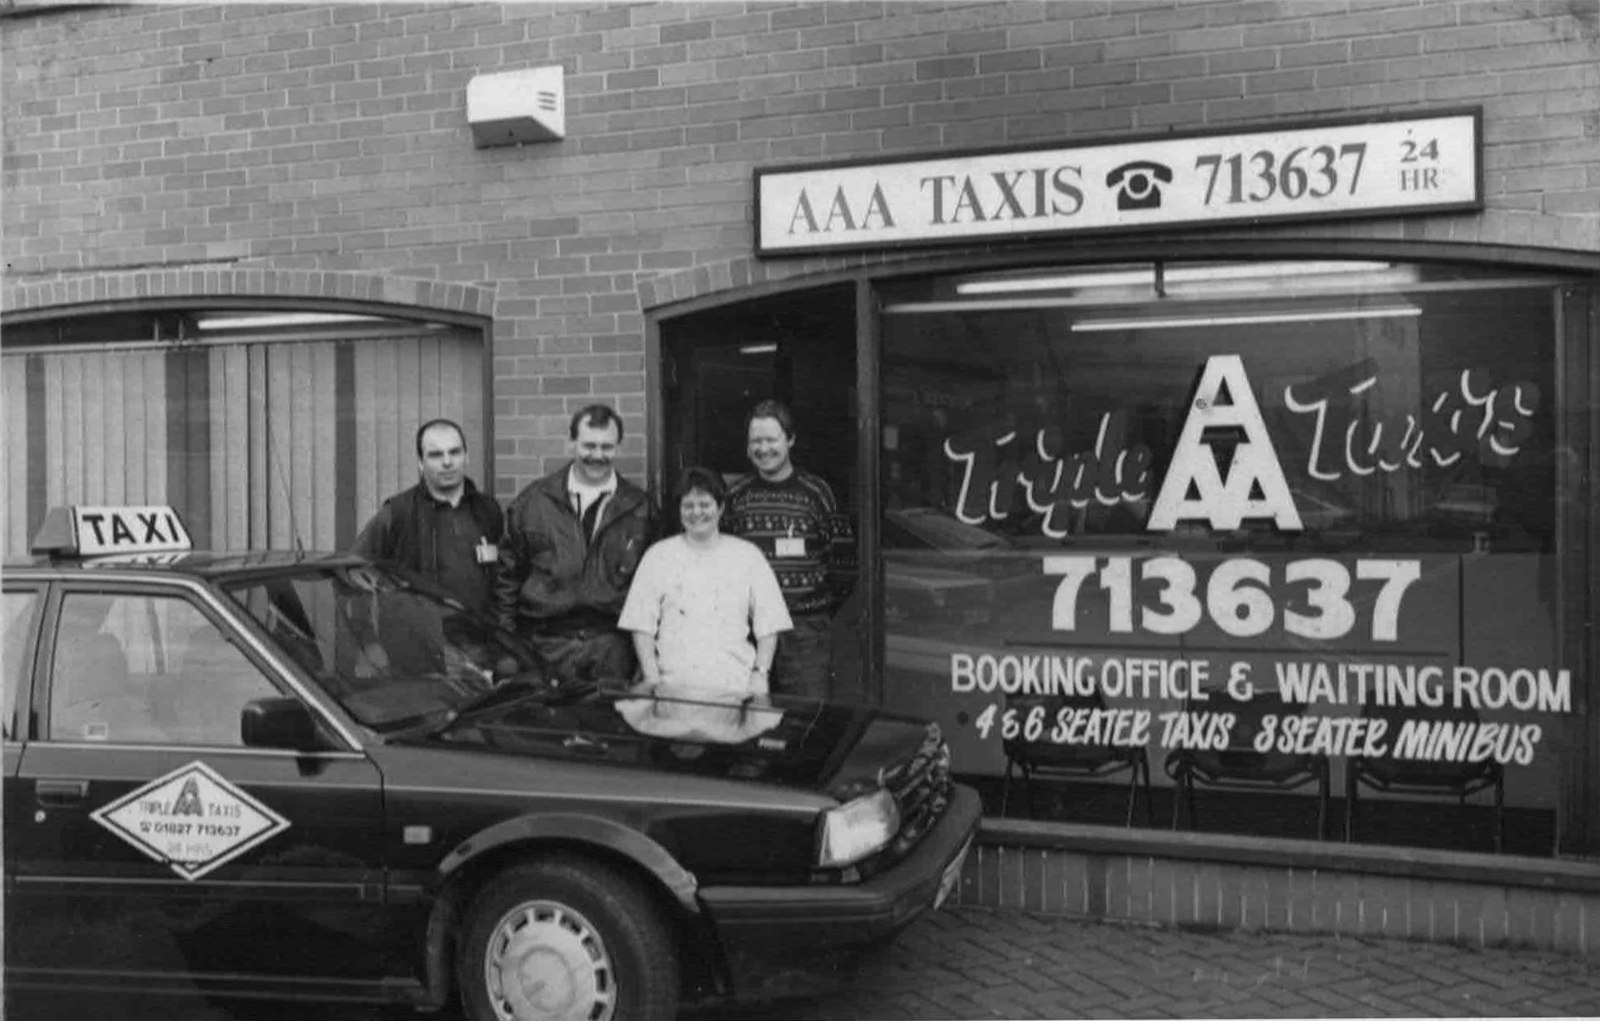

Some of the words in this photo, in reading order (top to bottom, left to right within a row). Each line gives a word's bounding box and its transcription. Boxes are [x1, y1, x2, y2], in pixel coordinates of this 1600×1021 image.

[1400, 138, 1439, 163] 24
[1400, 168, 1440, 192] HR
[788, 179, 898, 235] AAA
[919, 166, 1085, 226] TAXIS
[1194, 142, 1368, 206] 713637
[82, 513, 181, 546] TAXI
[1042, 555, 1422, 642] 713637
[951, 653, 1095, 697] BOOKING
[1101, 657, 1210, 702] OFFICE
[1226, 661, 1255, 702] &
[1275, 662, 1445, 708] WAITING
[1452, 666, 1572, 714] ROOM
[975, 703, 997, 740] 4
[1024, 706, 1046, 742] 6
[1051, 706, 1151, 748] SEATER
[1158, 711, 1236, 752] TAXIS
[1277, 716, 1388, 757] SEATER
[1392, 719, 1543, 767] MINIBUS
